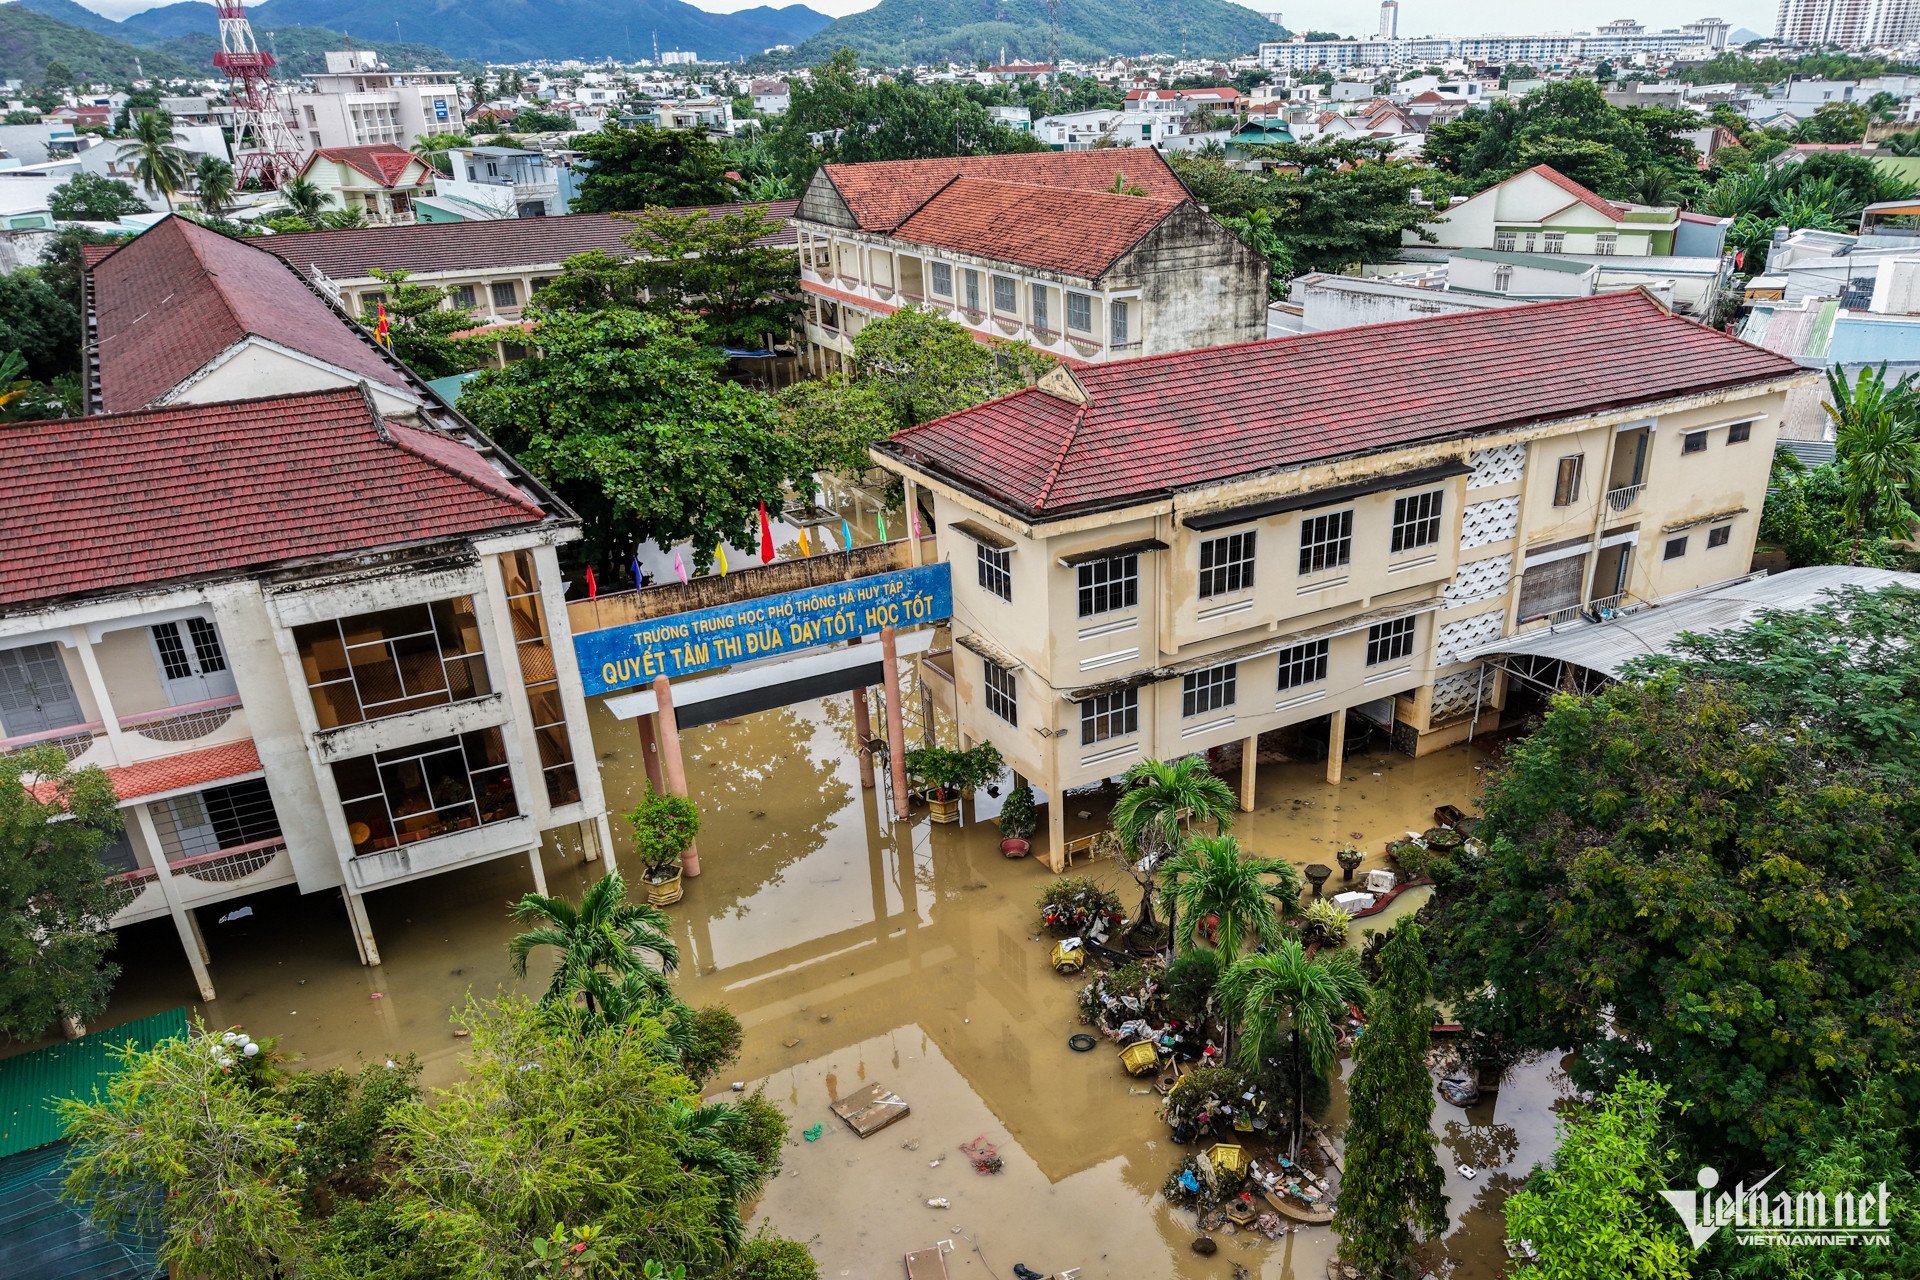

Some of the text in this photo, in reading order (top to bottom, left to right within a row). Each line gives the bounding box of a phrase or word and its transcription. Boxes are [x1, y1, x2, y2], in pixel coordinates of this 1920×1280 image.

[602, 644, 666, 685] QUYẾT
[670, 642, 710, 670] TÂM
[713, 634, 743, 660] THI
[746, 627, 783, 654] ĐUA
[865, 603, 899, 630] HỌC
[902, 589, 934, 620] TỐT
[634, 624, 689, 646] TRƯỜNG
[691, 615, 735, 634] TRUNG
[737, 608, 765, 625] HỌC
[768, 597, 794, 619] PHỔ
[795, 595, 837, 614] THÔNG
[838, 588, 856, 605] HÀ
[857, 586, 881, 602] HUY
